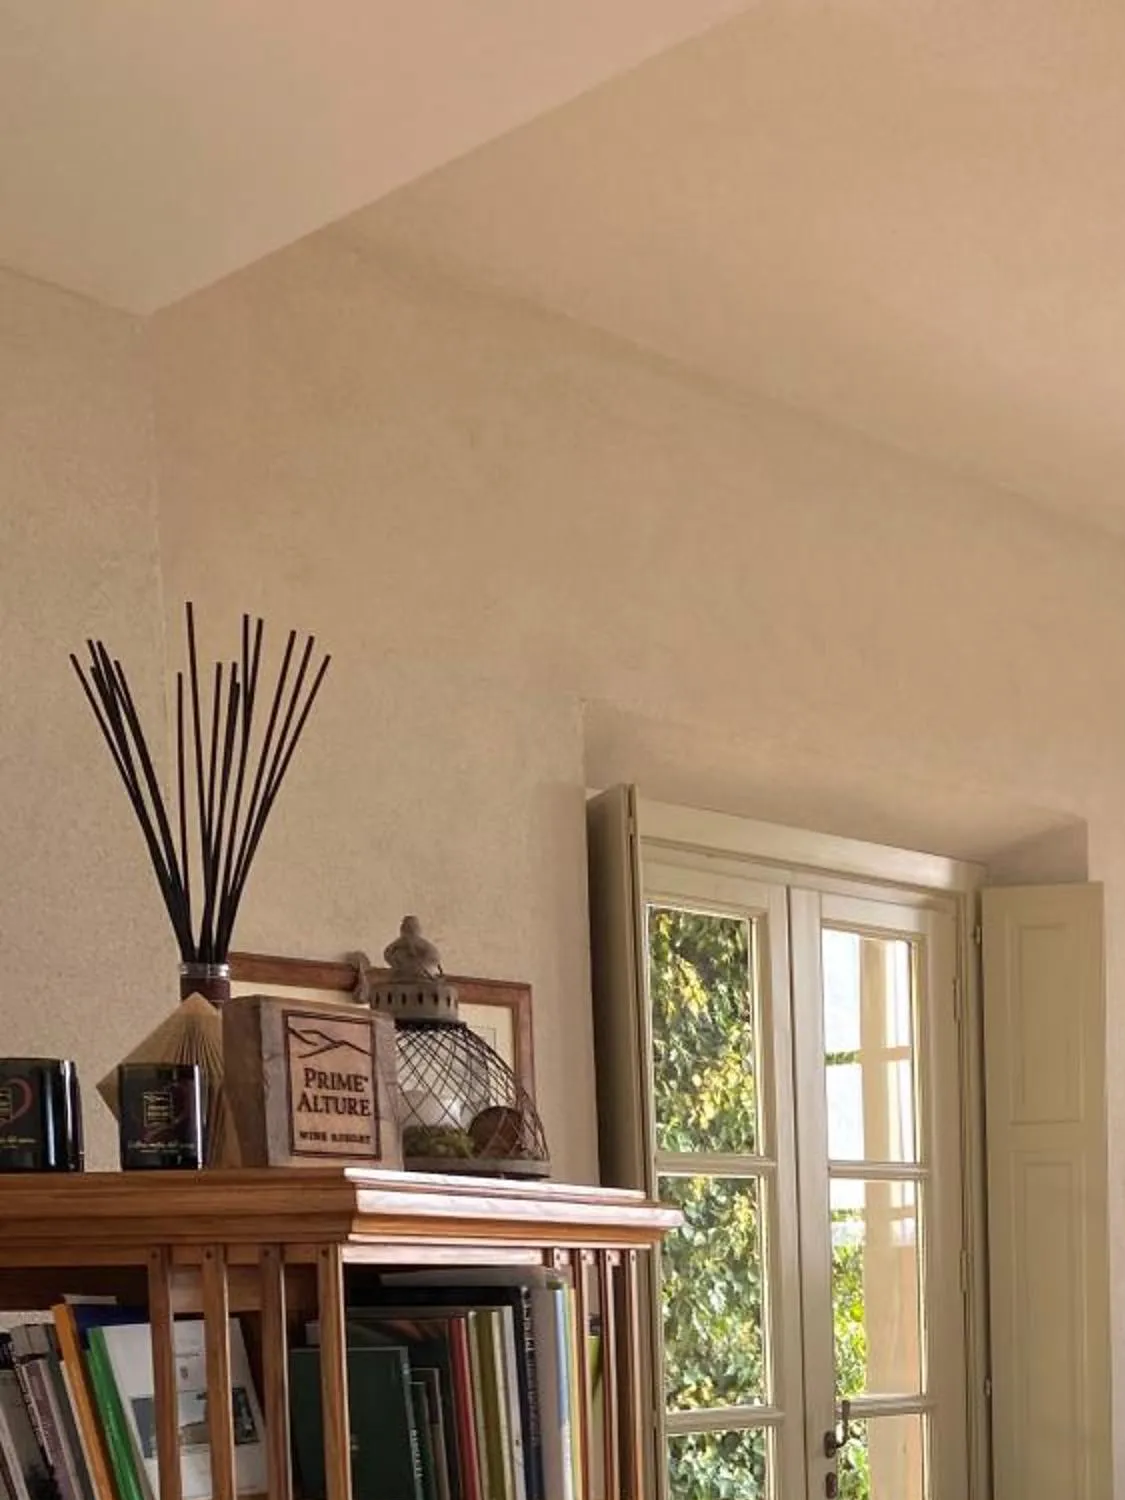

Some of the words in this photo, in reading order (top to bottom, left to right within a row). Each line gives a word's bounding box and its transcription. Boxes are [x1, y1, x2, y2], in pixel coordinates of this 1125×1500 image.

[304, 1068, 366, 1092] PRIME
[297, 1093, 372, 1116] ALTURE
[300, 1131, 327, 1141] WINE
